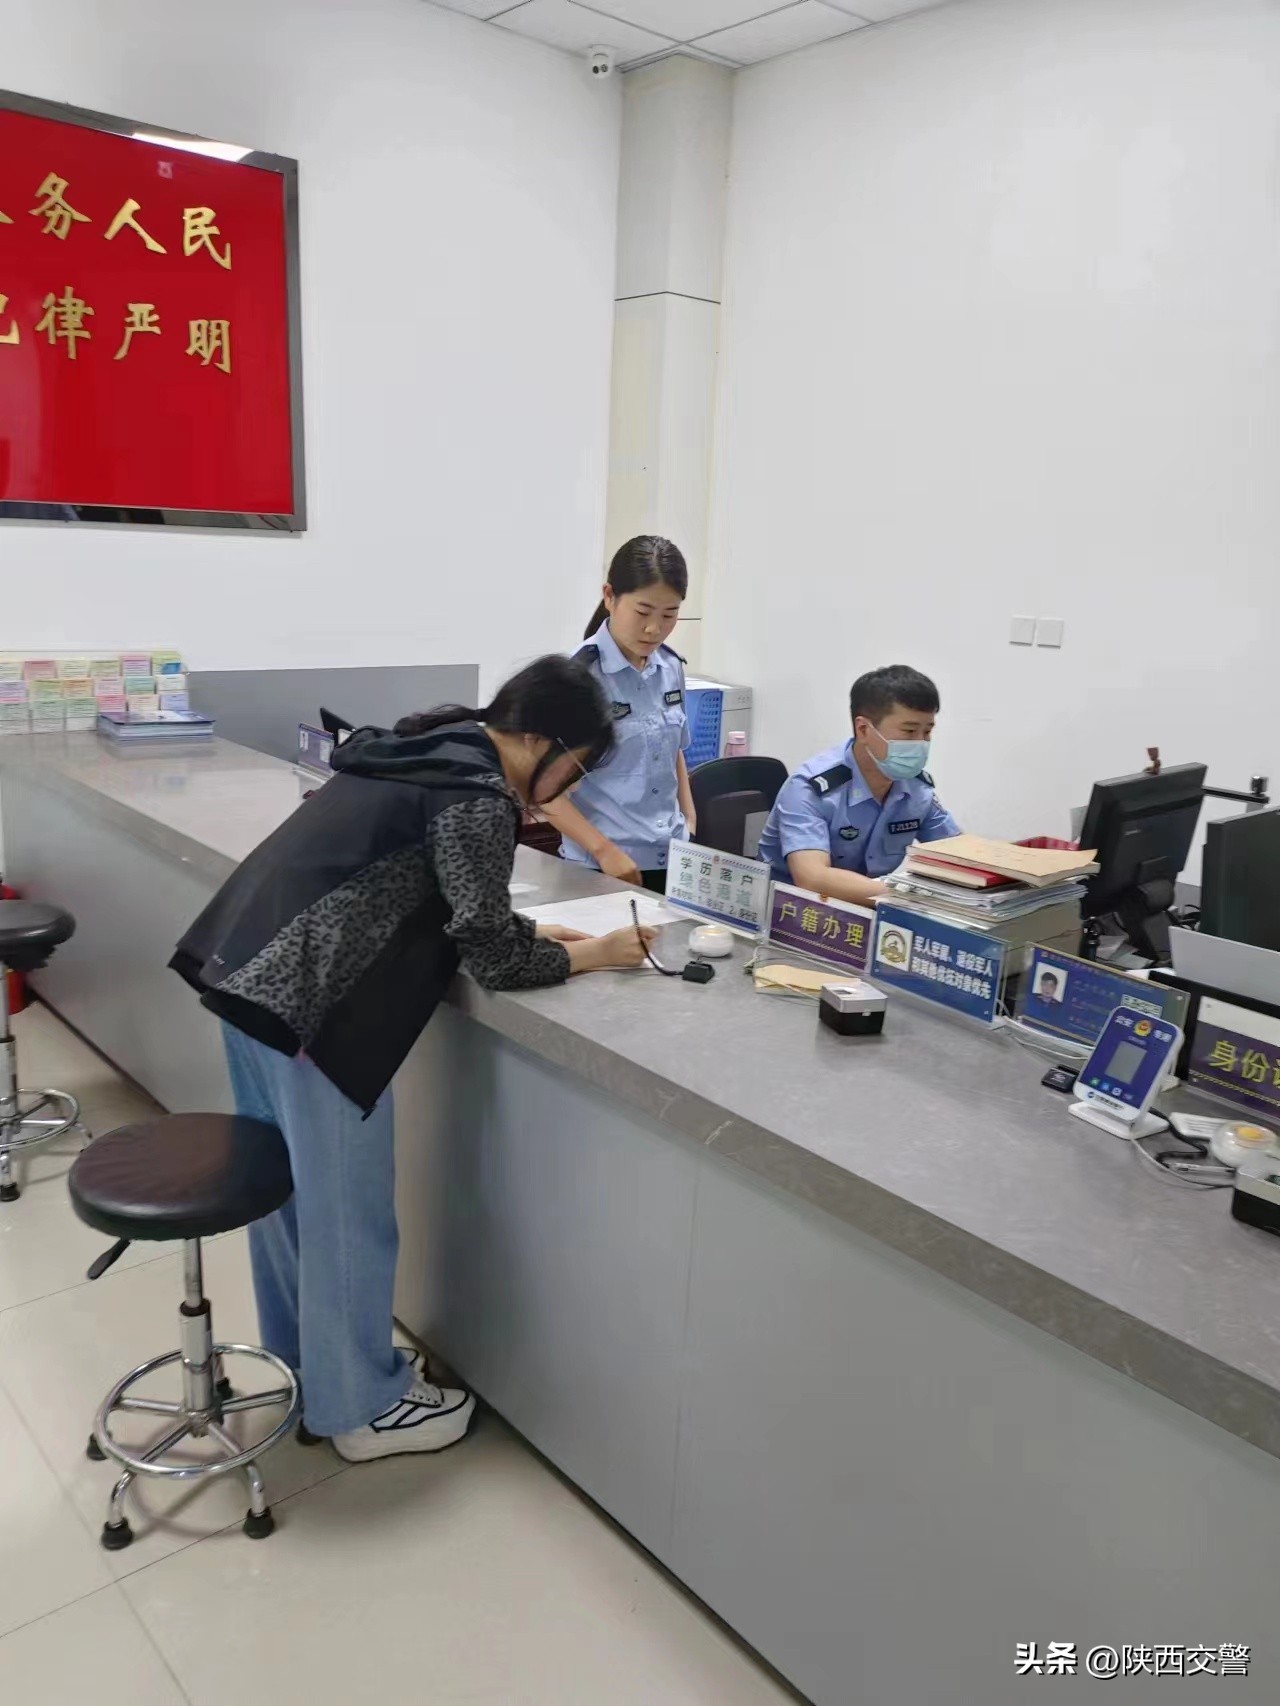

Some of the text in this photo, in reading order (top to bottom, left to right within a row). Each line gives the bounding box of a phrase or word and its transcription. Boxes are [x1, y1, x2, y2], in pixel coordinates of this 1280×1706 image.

[0, 171, 232, 270] 务人民
[679, 856, 753, 886] 学历落户
[679, 871, 752, 907] 绿色通道
[778, 900, 865, 949] 户籍办理
